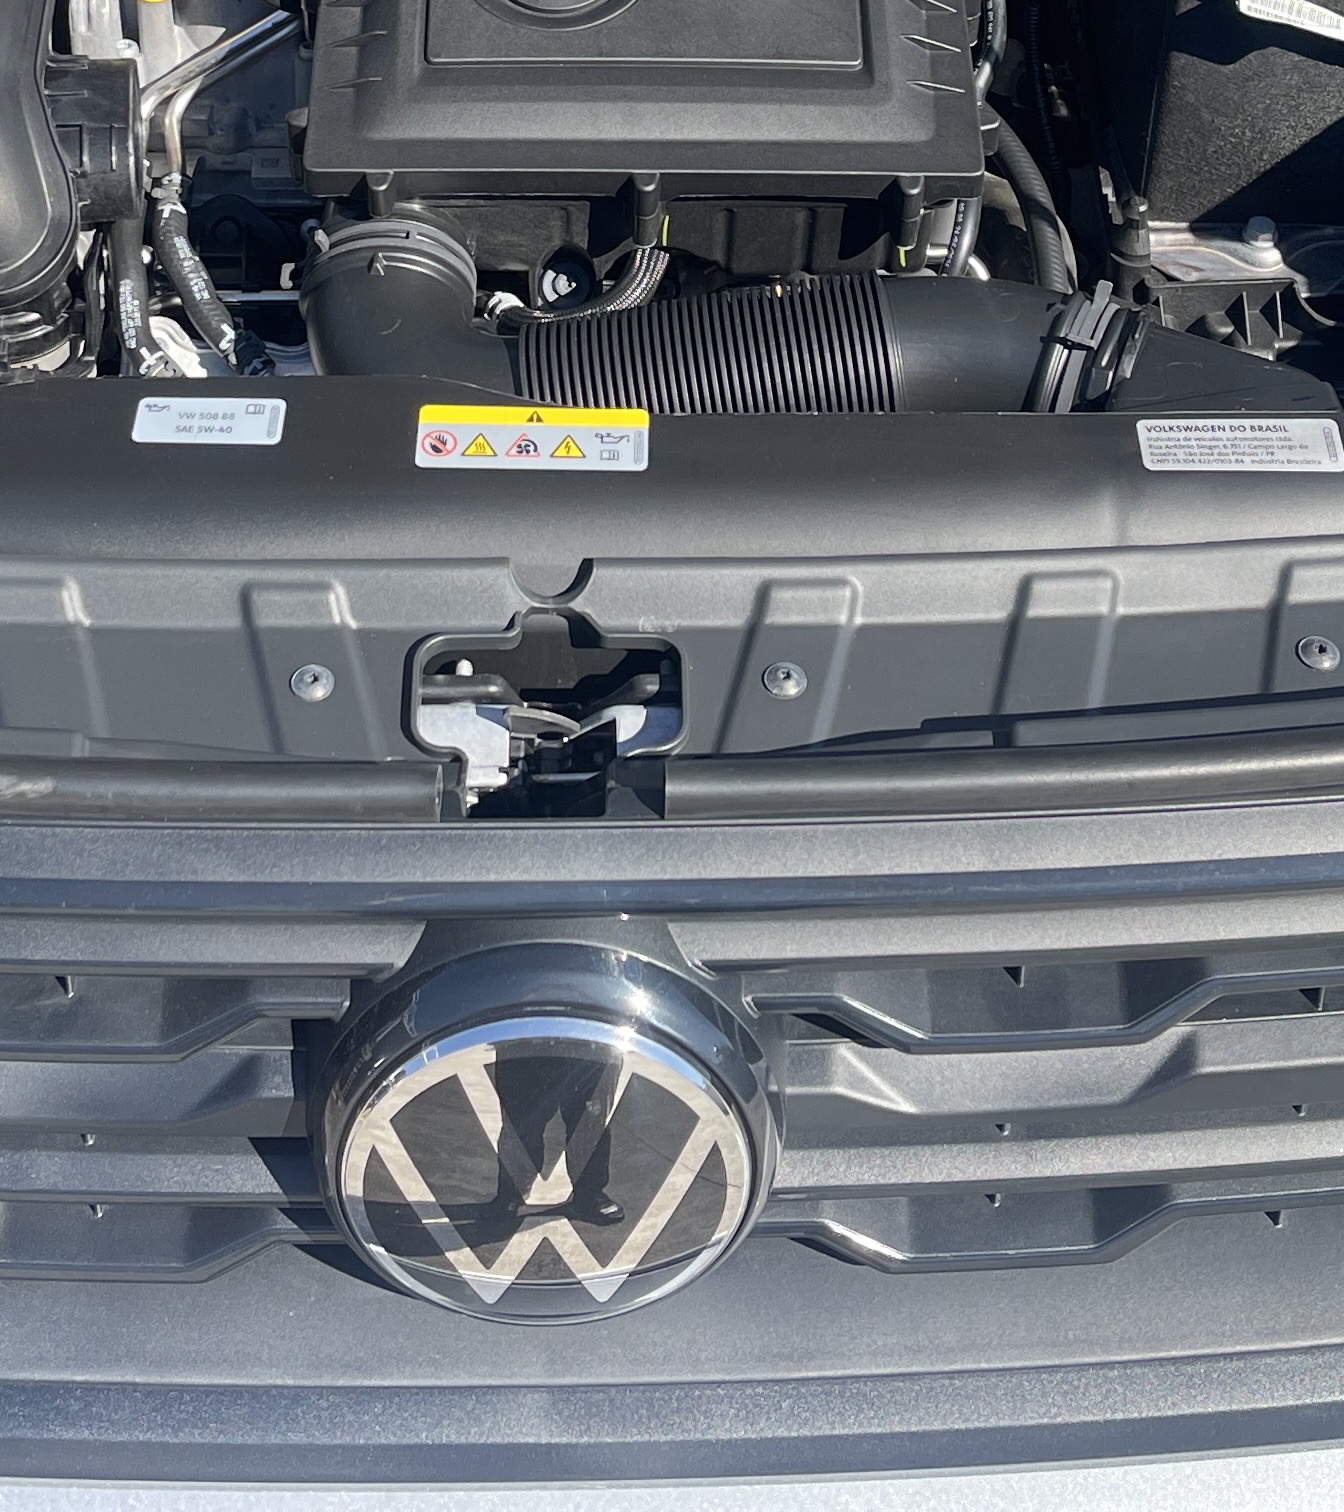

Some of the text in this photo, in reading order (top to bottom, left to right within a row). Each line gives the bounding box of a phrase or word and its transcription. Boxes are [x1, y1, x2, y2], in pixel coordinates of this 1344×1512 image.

[178, 412, 196, 420] VW
[175, 425, 233, 433] SAE 5W-40
[1145, 425, 1289, 433] VOLKSWAGEN DO BRASIL
[344, 1023, 753, 1318] VW
